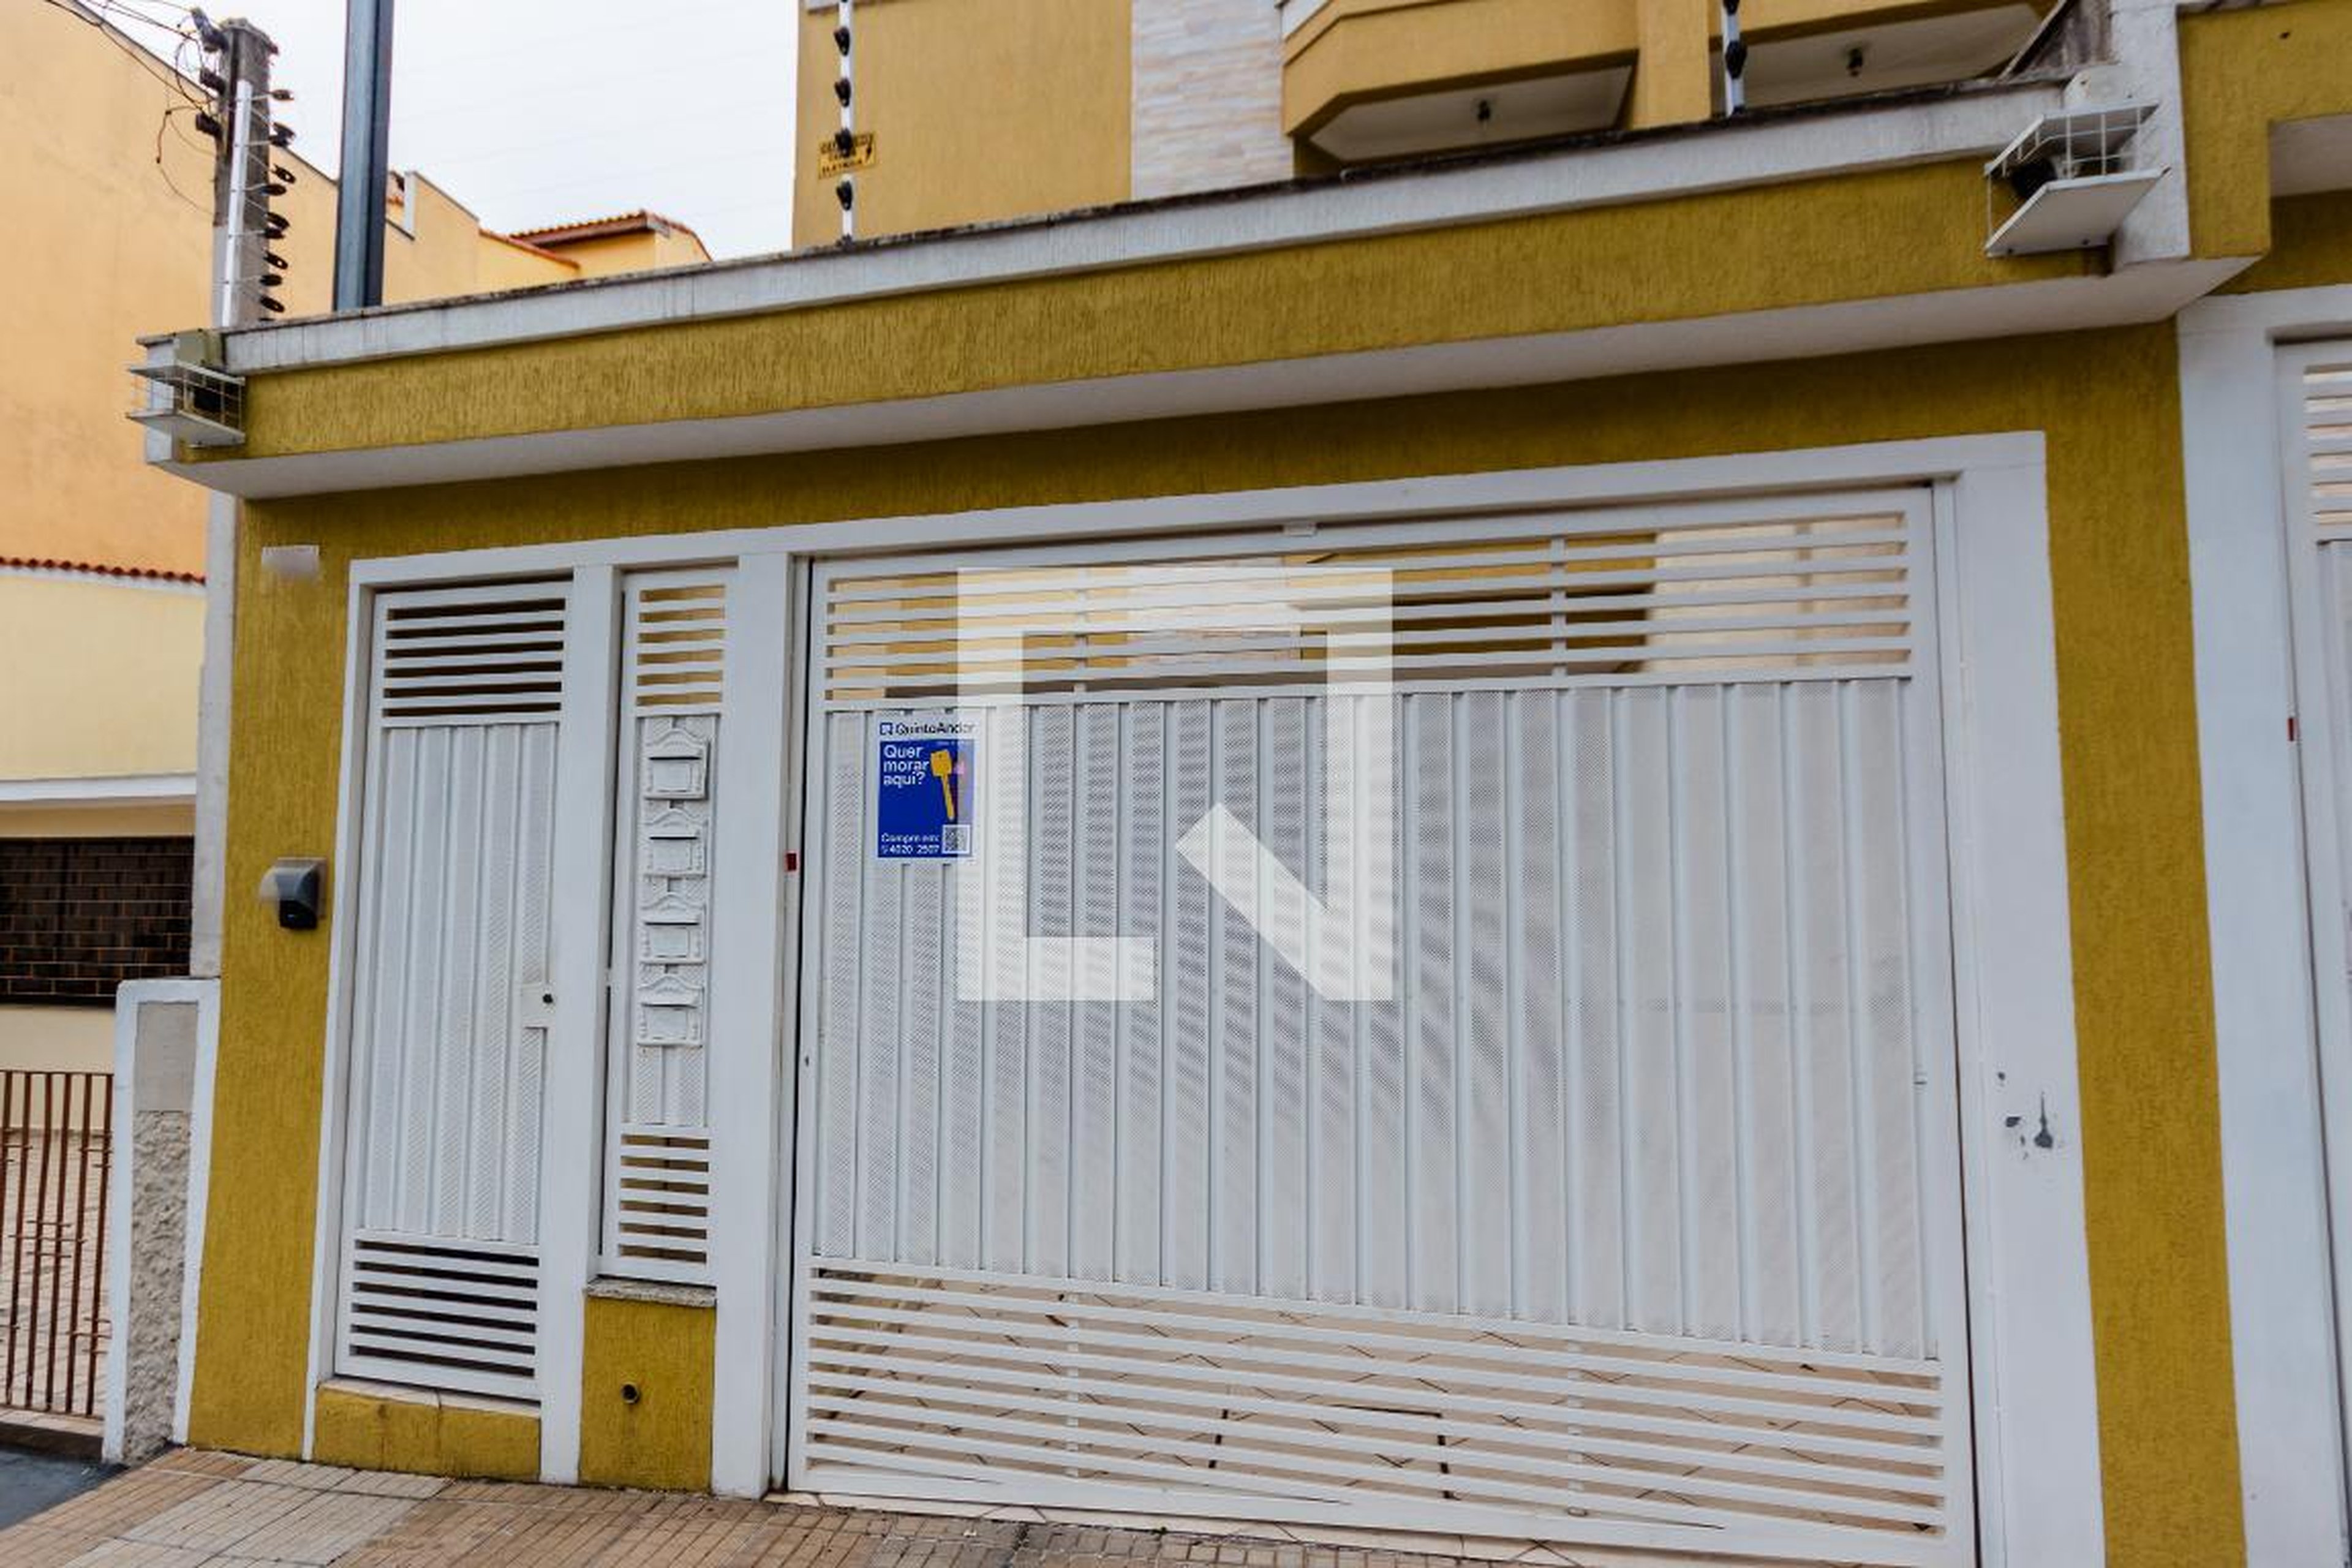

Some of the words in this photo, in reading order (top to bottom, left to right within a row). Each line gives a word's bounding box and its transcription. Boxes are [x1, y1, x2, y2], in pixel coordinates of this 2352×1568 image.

[883, 744, 924, 758] Quer
[883, 761, 930, 772] morar
[883, 771, 925, 788] aqui?
